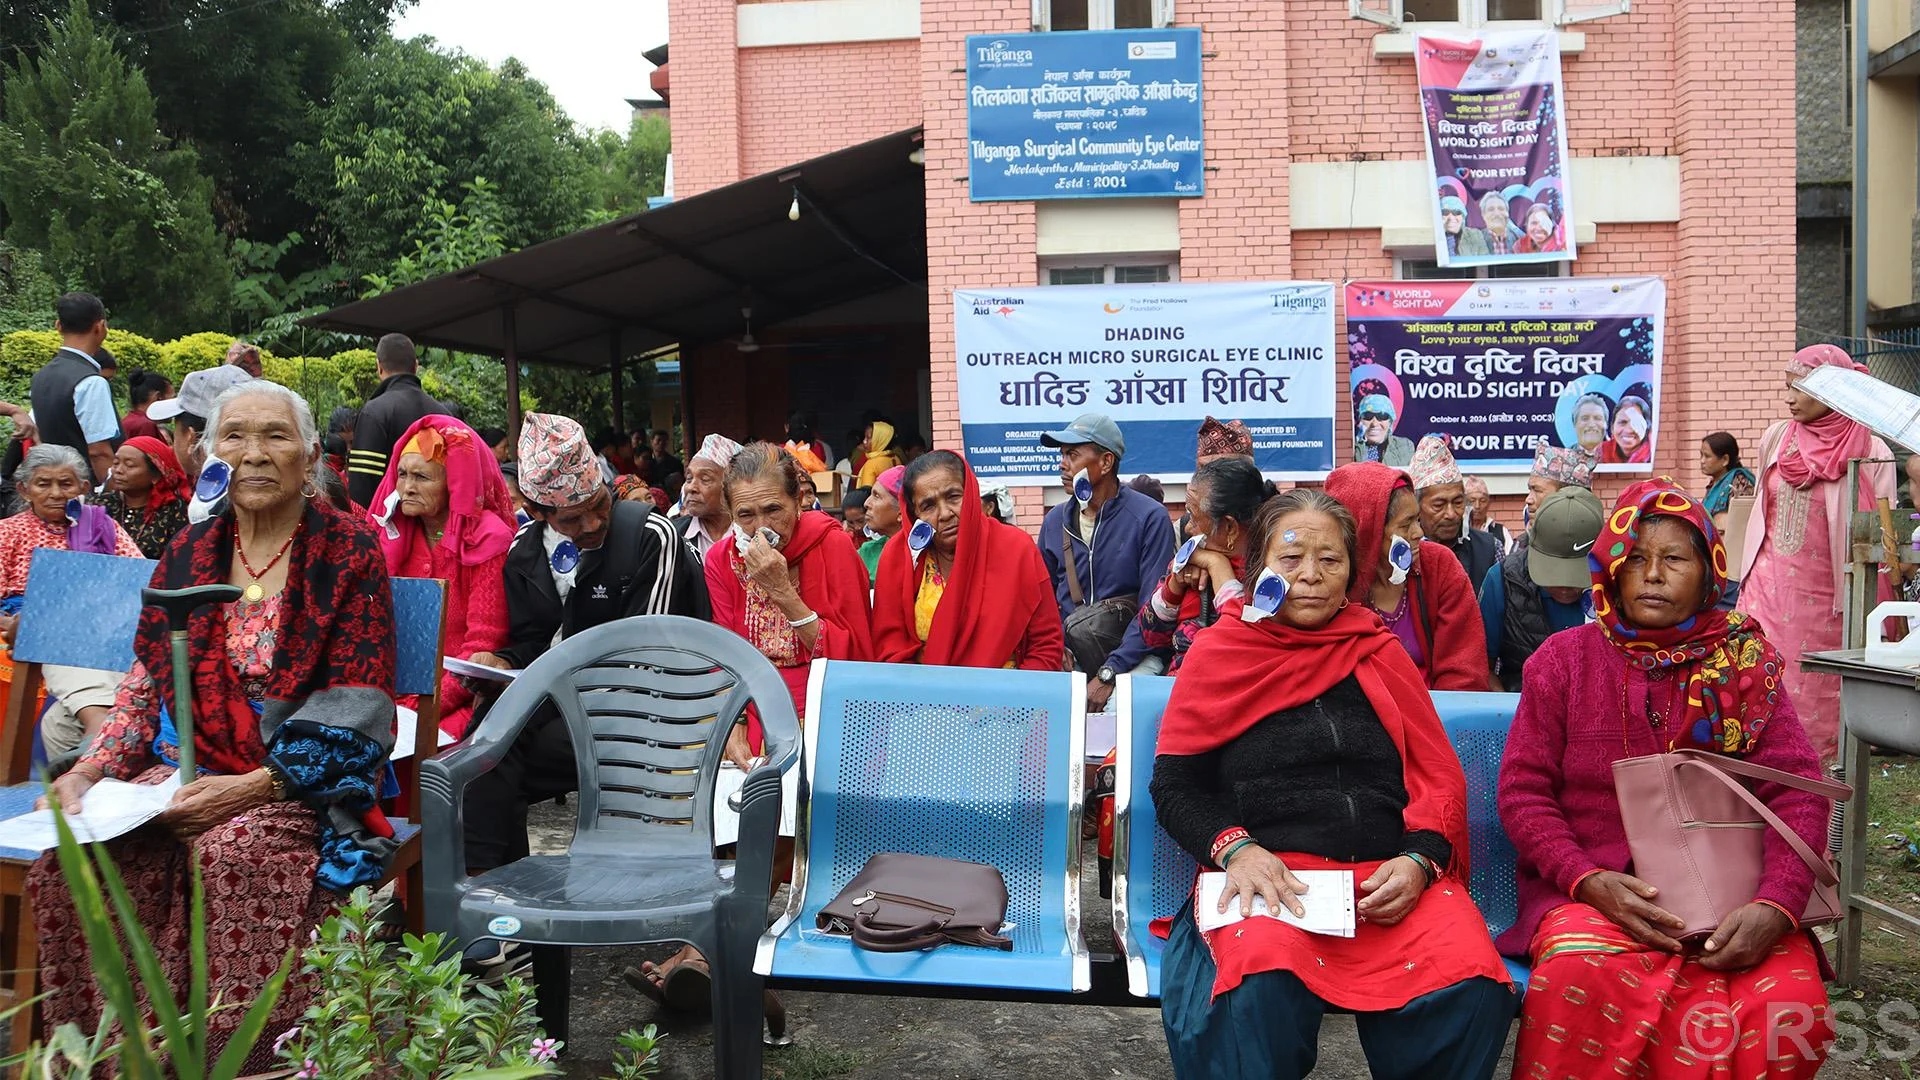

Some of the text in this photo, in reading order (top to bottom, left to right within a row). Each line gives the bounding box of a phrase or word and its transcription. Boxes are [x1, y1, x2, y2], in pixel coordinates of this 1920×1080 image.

[977, 47, 1033, 63] Tilganga
[971, 85, 1029, 107] तिलगंगा
[1030, 83, 1082, 106] सर्जिकल
[1083, 80, 1140, 106] सामुदायिक
[1172, 79, 1198, 103] केन्द्र
[1438, 119, 1537, 138] विश्व दृष्टि दिवस
[1438, 134, 1539, 148] WORLD SIGHT DAY
[971, 134, 1200, 163] Tilganga Surgical Community Eye Center
[1004, 162, 1068, 176] Neelakantha
[1470, 167, 1527, 178] YOUR EYES
[1055, 177, 1083, 189] Estd
[1094, 176, 1127, 188] 2001
[1393, 289, 1432, 299] WORLD
[973, 297, 1024, 306] Australian
[1271, 294, 1326, 311] Tilganga
[1393, 299, 1444, 309] SIGHT DAY
[973, 307, 990, 315] Aid
[1105, 327, 1185, 341] DHADING
[1457, 323, 1482, 332] माया
[1510, 320, 1548, 334] दृष्टिको
[1550, 322, 1571, 332] रक्षा
[1421, 333, 1579, 347] Love your eyes, save your sight
[966, 346, 1324, 367] OUTREACH MICRO SURGICAL EYE CLINIC
[1395, 347, 1605, 381] विश्व दृष्टि दिवस
[1000, 367, 1291, 408] धादिङ आँखा शिविर
[1409, 381, 1589, 399] WORLD SIGHT DAY
[1430, 415, 1459, 423] October
[1469, 415, 1487, 423] 2026
[1005, 431, 1041, 439] ORGANIZE
[1248, 426, 1296, 434] UPPORTED BY:
[1282, 441, 1323, 449] FOUNDATION
[1451, 435, 1500, 450] YOUR
[970, 446, 1002, 454] TILGANGA
[1003, 446, 1035, 454] SURGICAL
[973, 464, 1006, 473] TILGANGA
[1007, 464, 1041, 472] INSTITUTE
[1041, 464, 1050, 472] OF
